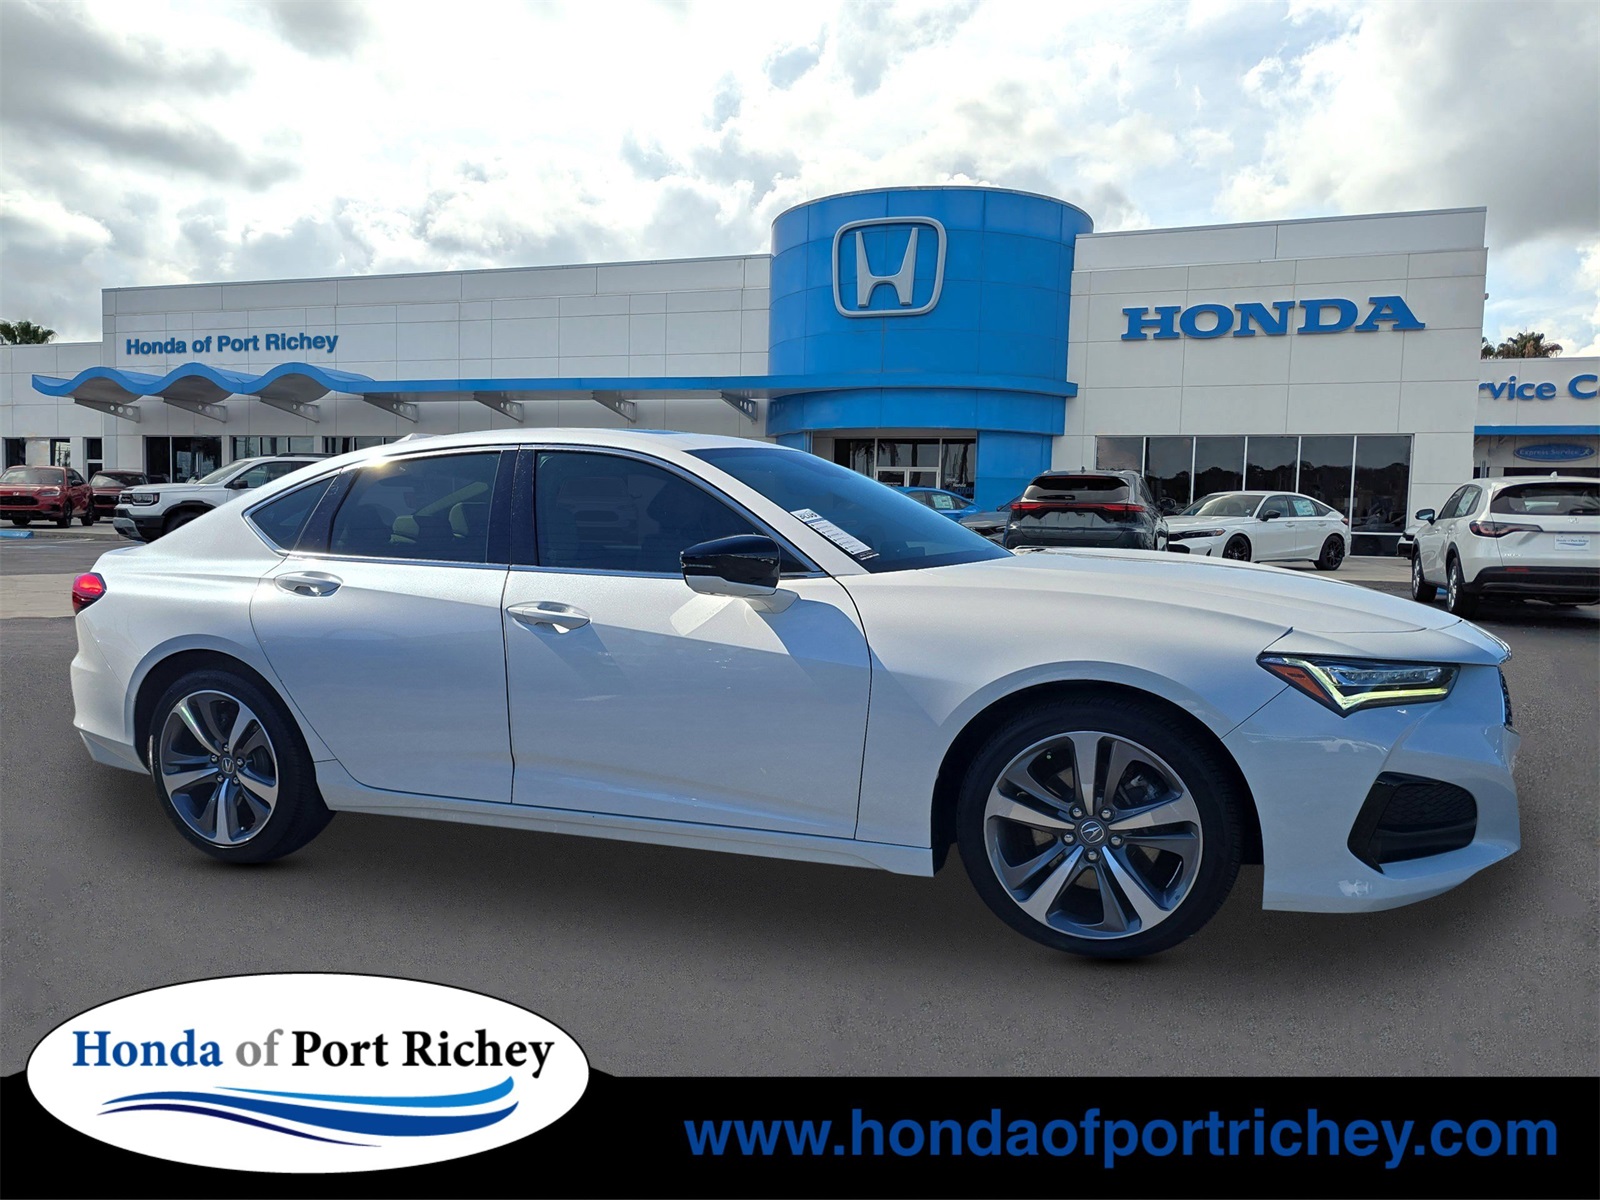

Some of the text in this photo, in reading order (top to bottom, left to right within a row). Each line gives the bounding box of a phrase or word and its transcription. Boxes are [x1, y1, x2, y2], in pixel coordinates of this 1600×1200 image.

[1121, 295, 1426, 341] HONDA
[125, 332, 339, 356] Honda of Port Richey
[1567, 373, 1600, 400] C
